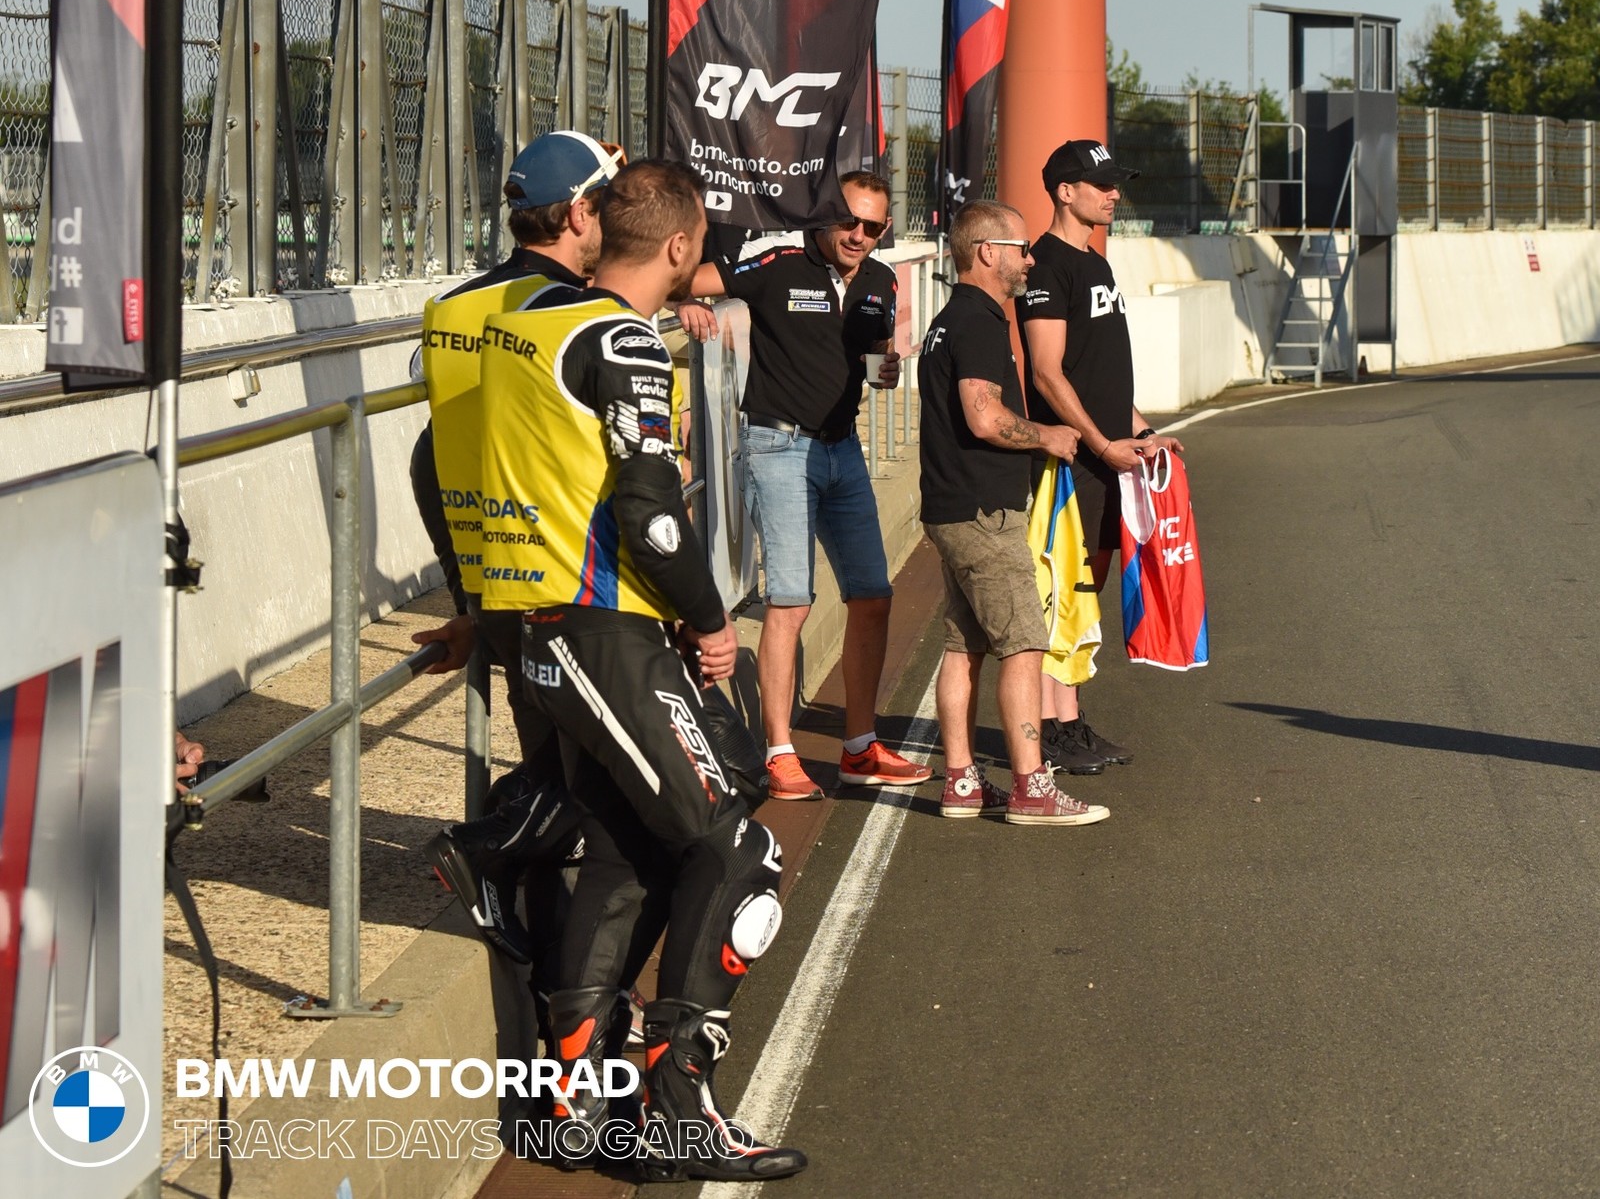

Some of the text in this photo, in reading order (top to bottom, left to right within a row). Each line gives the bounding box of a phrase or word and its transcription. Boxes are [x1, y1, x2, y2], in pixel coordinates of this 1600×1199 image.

[695, 62, 842, 128] BMC
[690, 138, 824, 176] bmc-moto.com
[655, 689, 729, 794] RST
